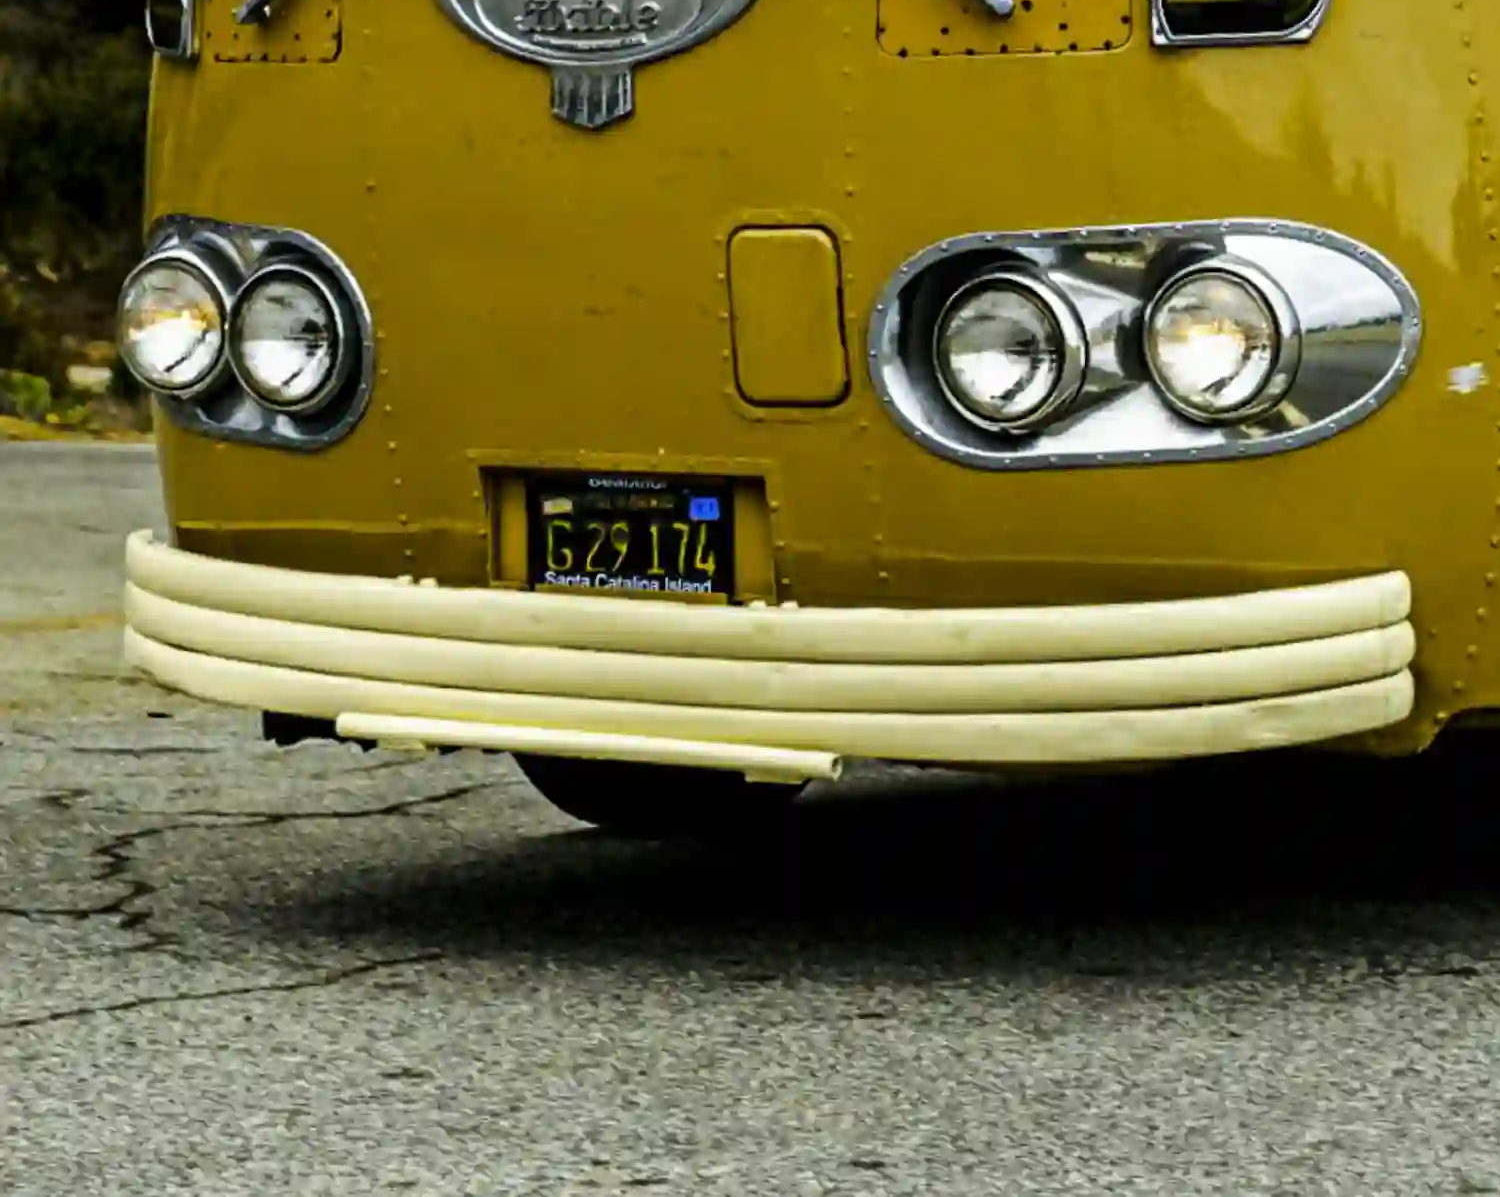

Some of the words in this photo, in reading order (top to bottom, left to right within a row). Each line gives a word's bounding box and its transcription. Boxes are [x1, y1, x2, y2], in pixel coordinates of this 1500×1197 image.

[544, 570, 591, 586] Santa
[595, 573, 660, 590] Catalina
[664, 576, 713, 593] Island
